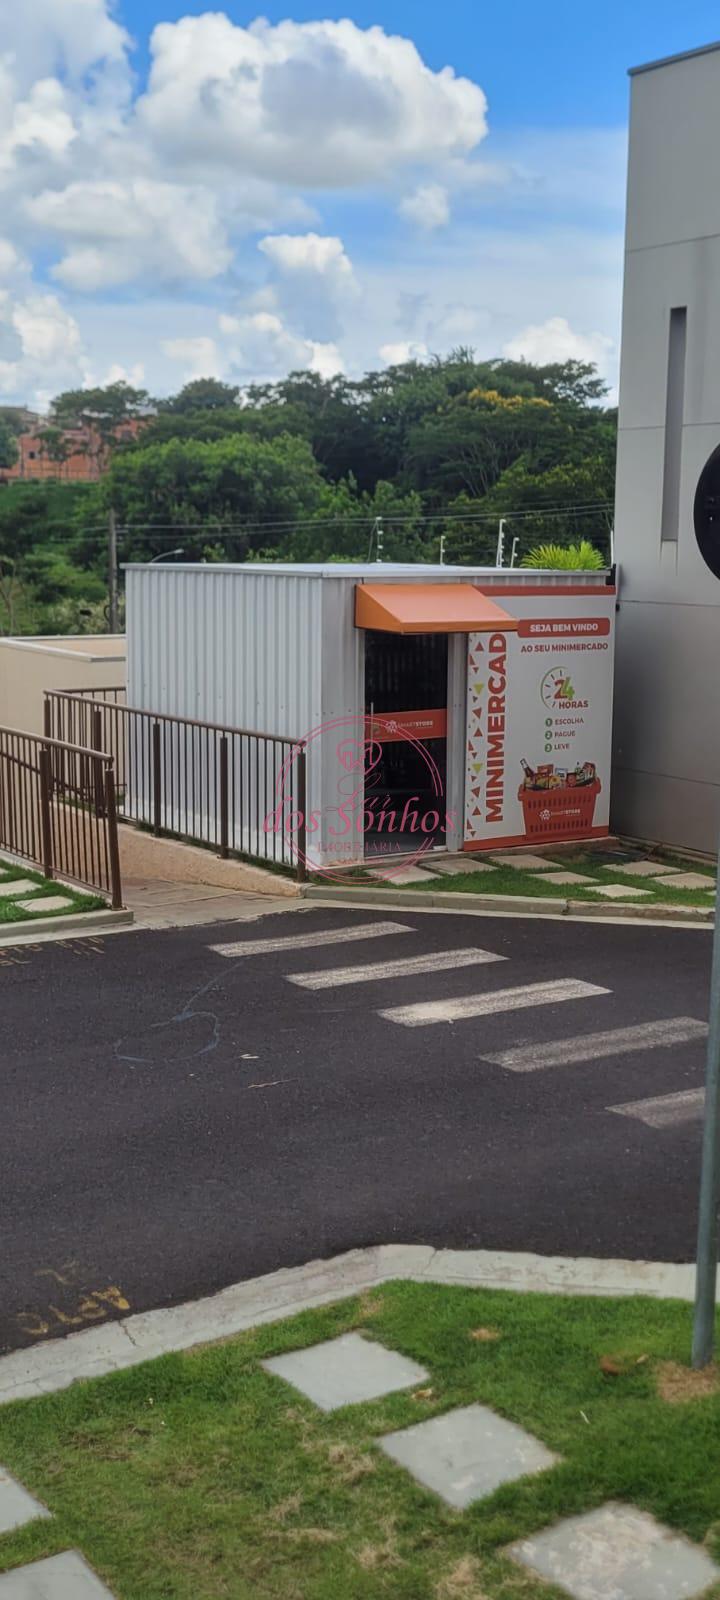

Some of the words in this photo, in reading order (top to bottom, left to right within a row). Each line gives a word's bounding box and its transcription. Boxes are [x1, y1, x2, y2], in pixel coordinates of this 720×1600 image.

[530, 623, 551, 632] SEJA
[552, 623, 571, 632] BEM
[573, 622, 598, 631] VINDO
[521, 645, 533, 653] AO
[534, 645, 550, 653] SEU
[551, 642, 609, 652] MINIMERCADO
[554, 677, 575, 700] 24
[558, 700, 589, 710] HORAS
[554, 717, 584, 725] ESCOLHA
[485, 633, 507, 823] MINIMERCAD
